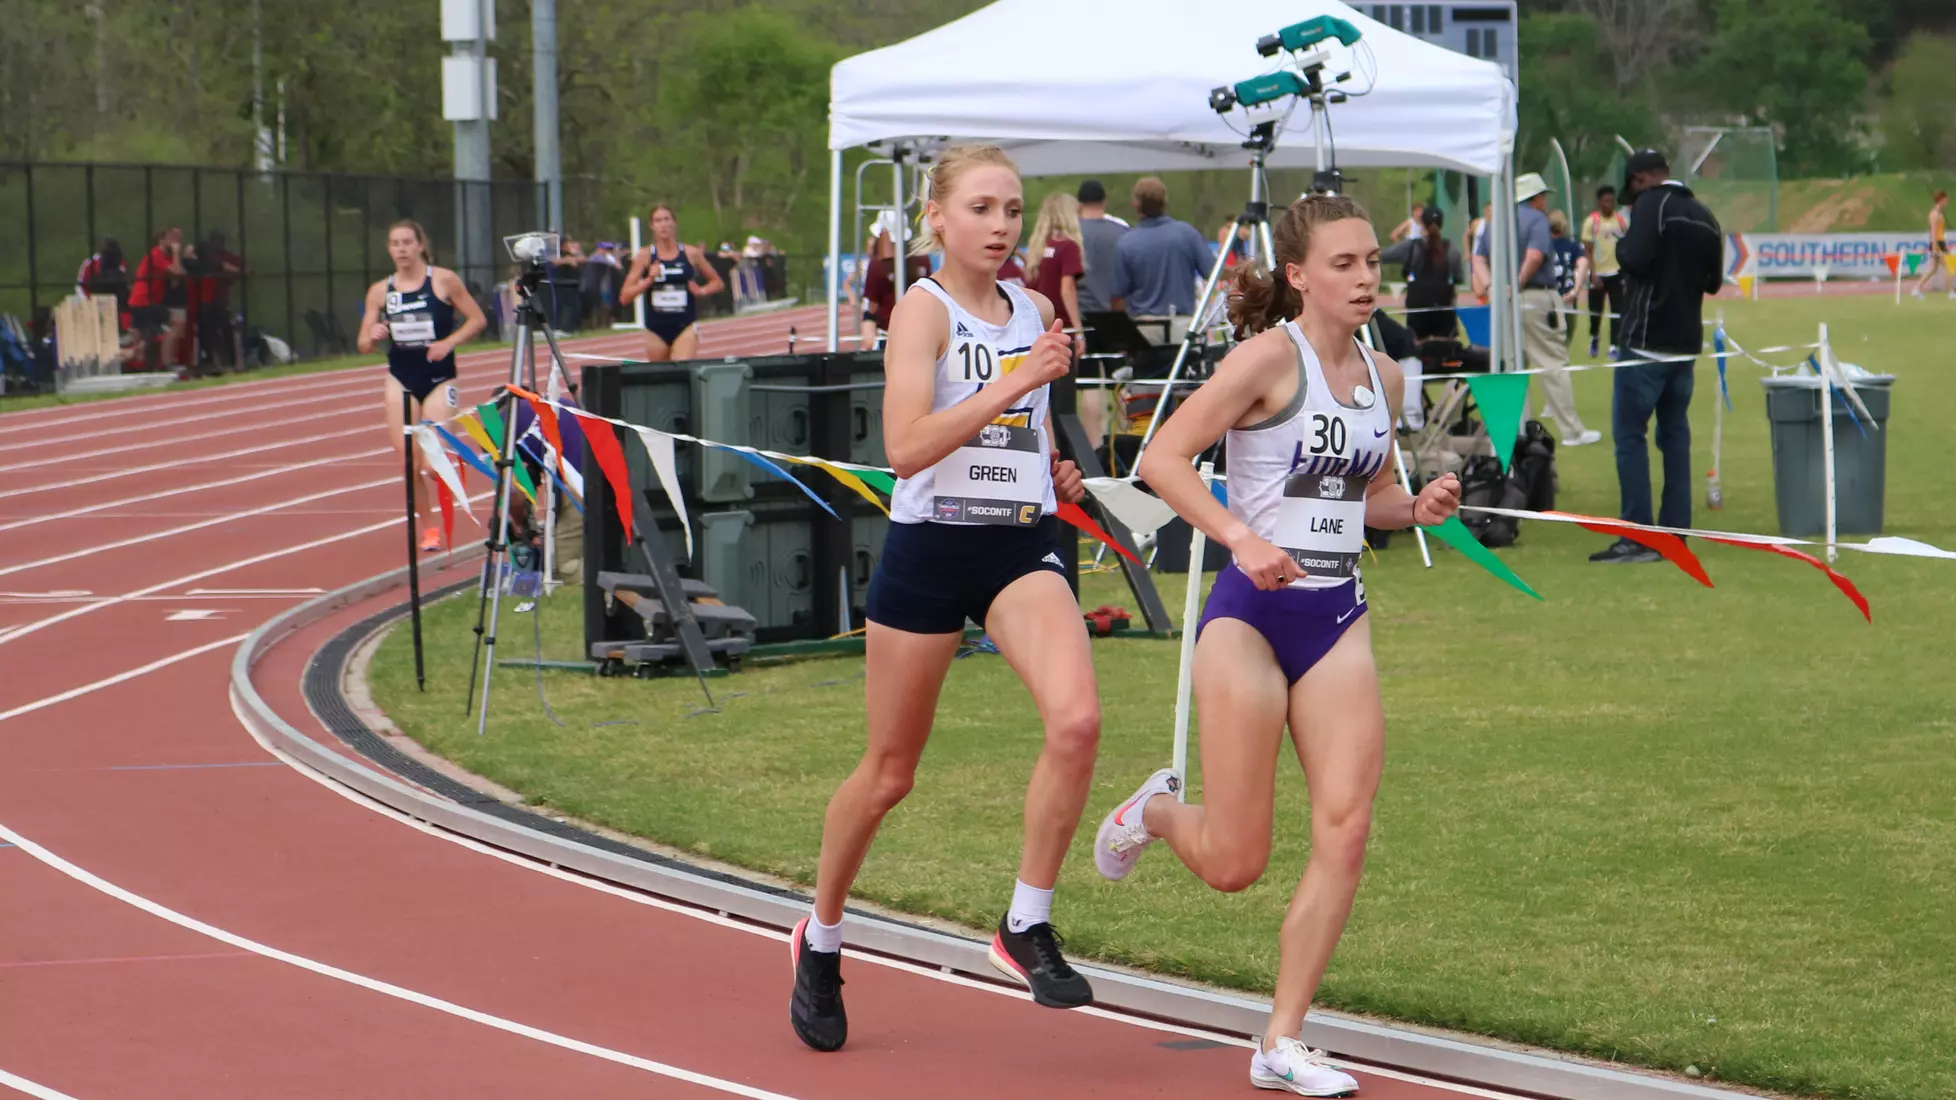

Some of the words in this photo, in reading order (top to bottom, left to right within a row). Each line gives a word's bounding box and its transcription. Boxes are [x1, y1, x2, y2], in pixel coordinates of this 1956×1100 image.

[1757, 240, 1887, 267] SOUTHERN
[958, 342, 993, 381] 10
[1310, 414, 1347, 455] 30
[969, 465, 1017, 483] GREEN
[967, 505, 1012, 517] #SOCONTF
[1310, 517, 1344, 535] LANE
[1300, 558, 1340, 569] #SOCONTF
